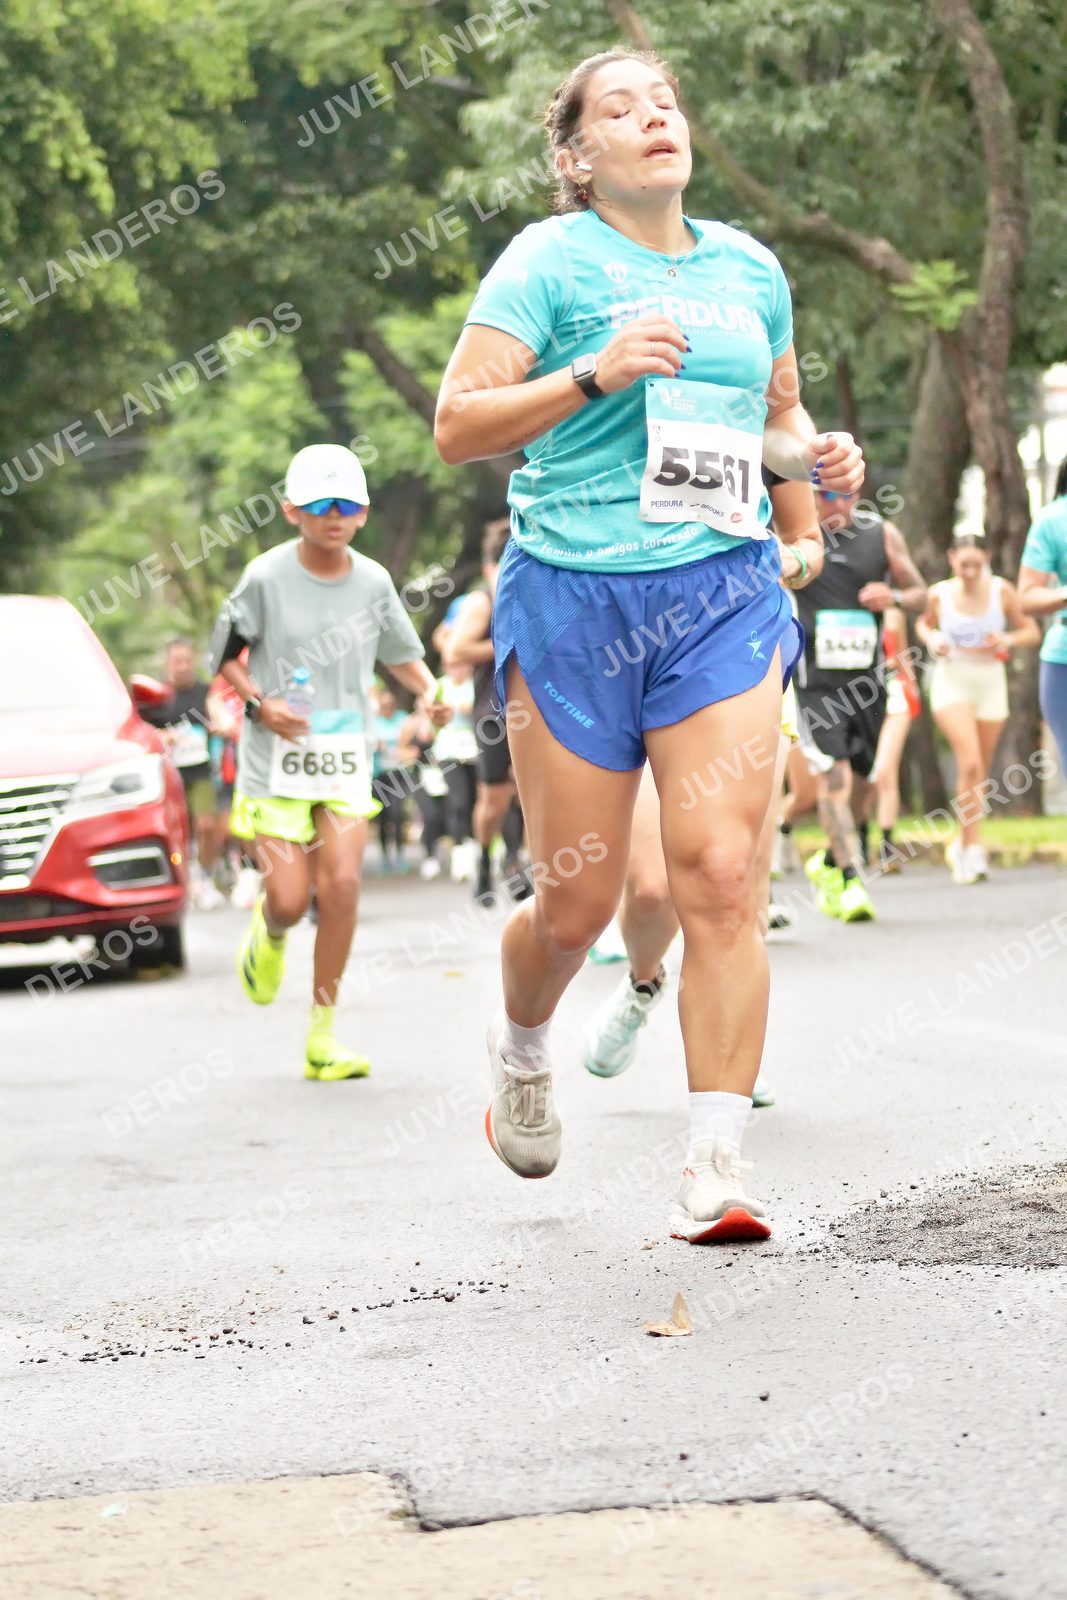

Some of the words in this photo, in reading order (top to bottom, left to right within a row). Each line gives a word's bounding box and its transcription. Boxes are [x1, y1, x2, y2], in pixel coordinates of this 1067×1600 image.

[653, 447, 750, 504] 5561
[651, 500, 683, 508] PERDURA
[544, 680, 594, 728] TOPTIME
[282, 752, 357, 776] 6685
